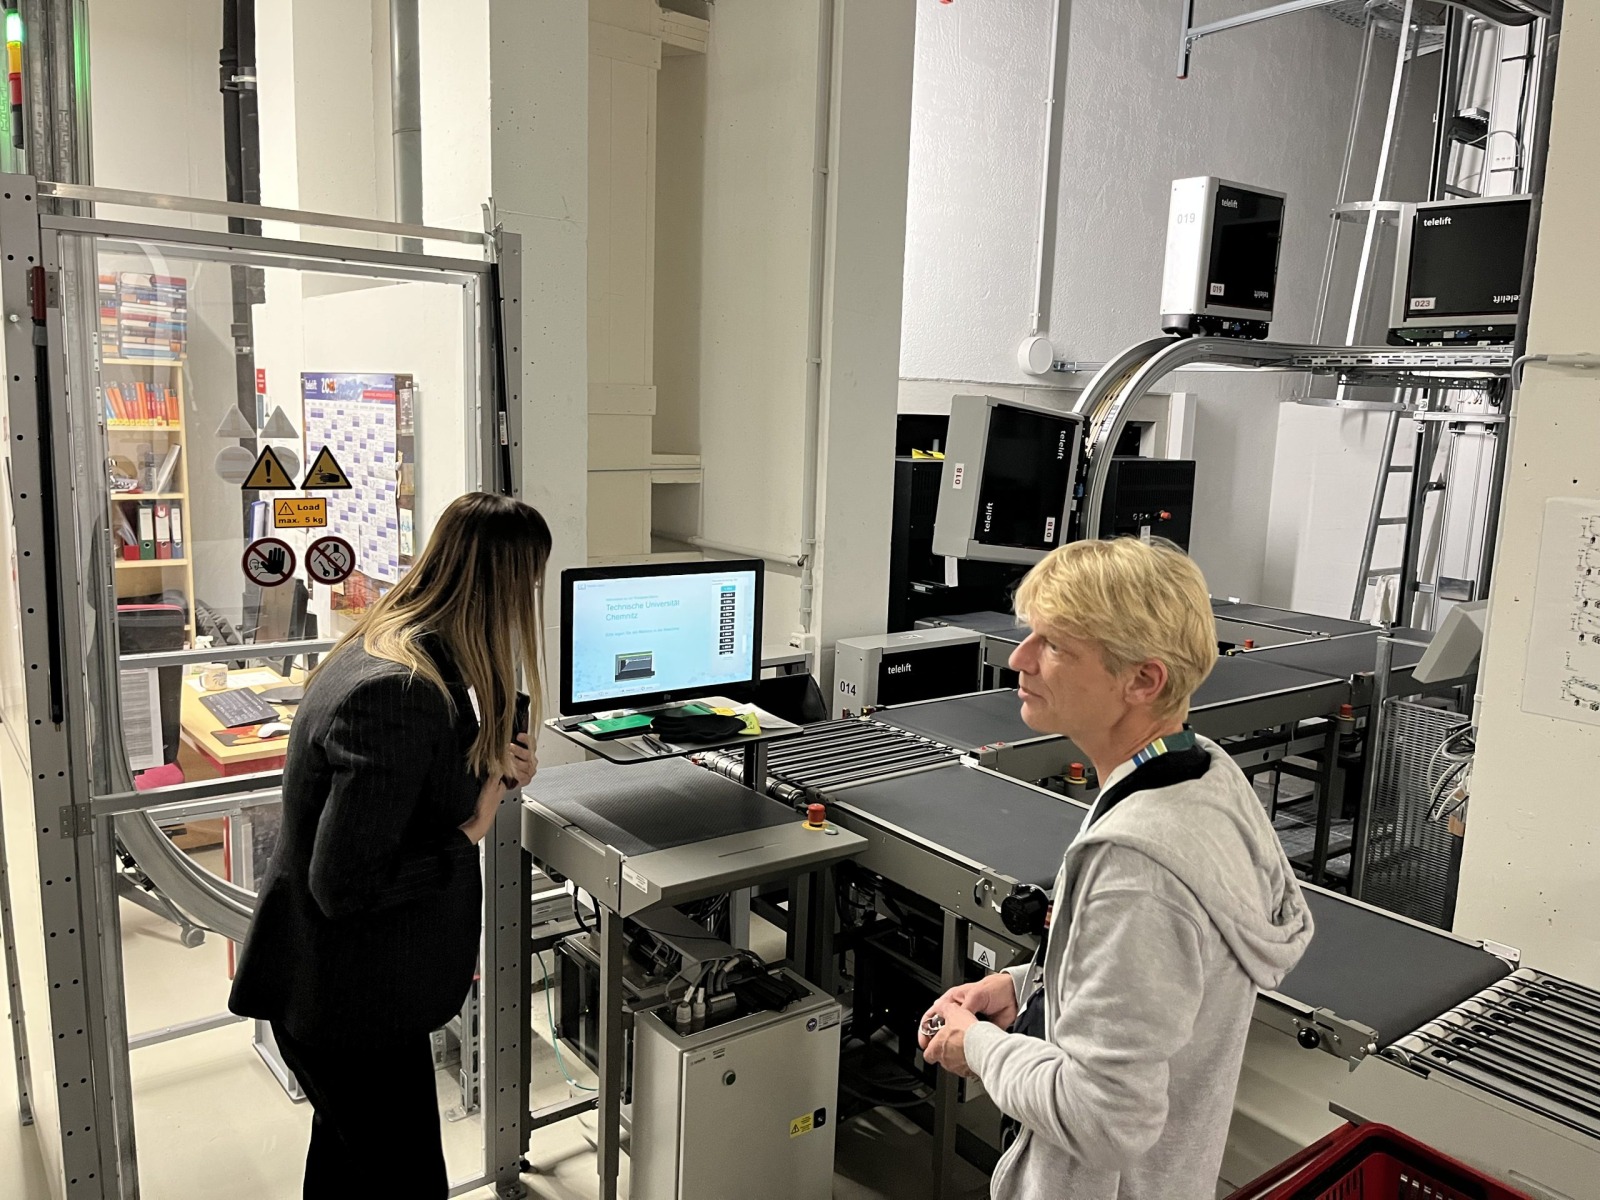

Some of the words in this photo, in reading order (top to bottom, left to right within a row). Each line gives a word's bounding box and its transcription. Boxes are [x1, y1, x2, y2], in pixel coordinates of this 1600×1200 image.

[1221, 198, 1238, 209] telelift
[1177, 212, 1196, 225] 019
[1423, 216, 1452, 227] telelift
[1212, 284, 1223, 294] 019
[1414, 299, 1431, 308] 023
[1056, 430, 1066, 460] telelift
[954, 467, 963, 485] 018
[297, 503, 320, 511] Load
[312, 516, 324, 525] kg
[983, 502, 994, 532] telelift
[1046, 521, 1054, 538] 018
[606, 602, 644, 611] Technische
[605, 612, 639, 621] Chemnitz
[887, 662, 912, 675] telelift
[839, 680, 857, 696] 014
